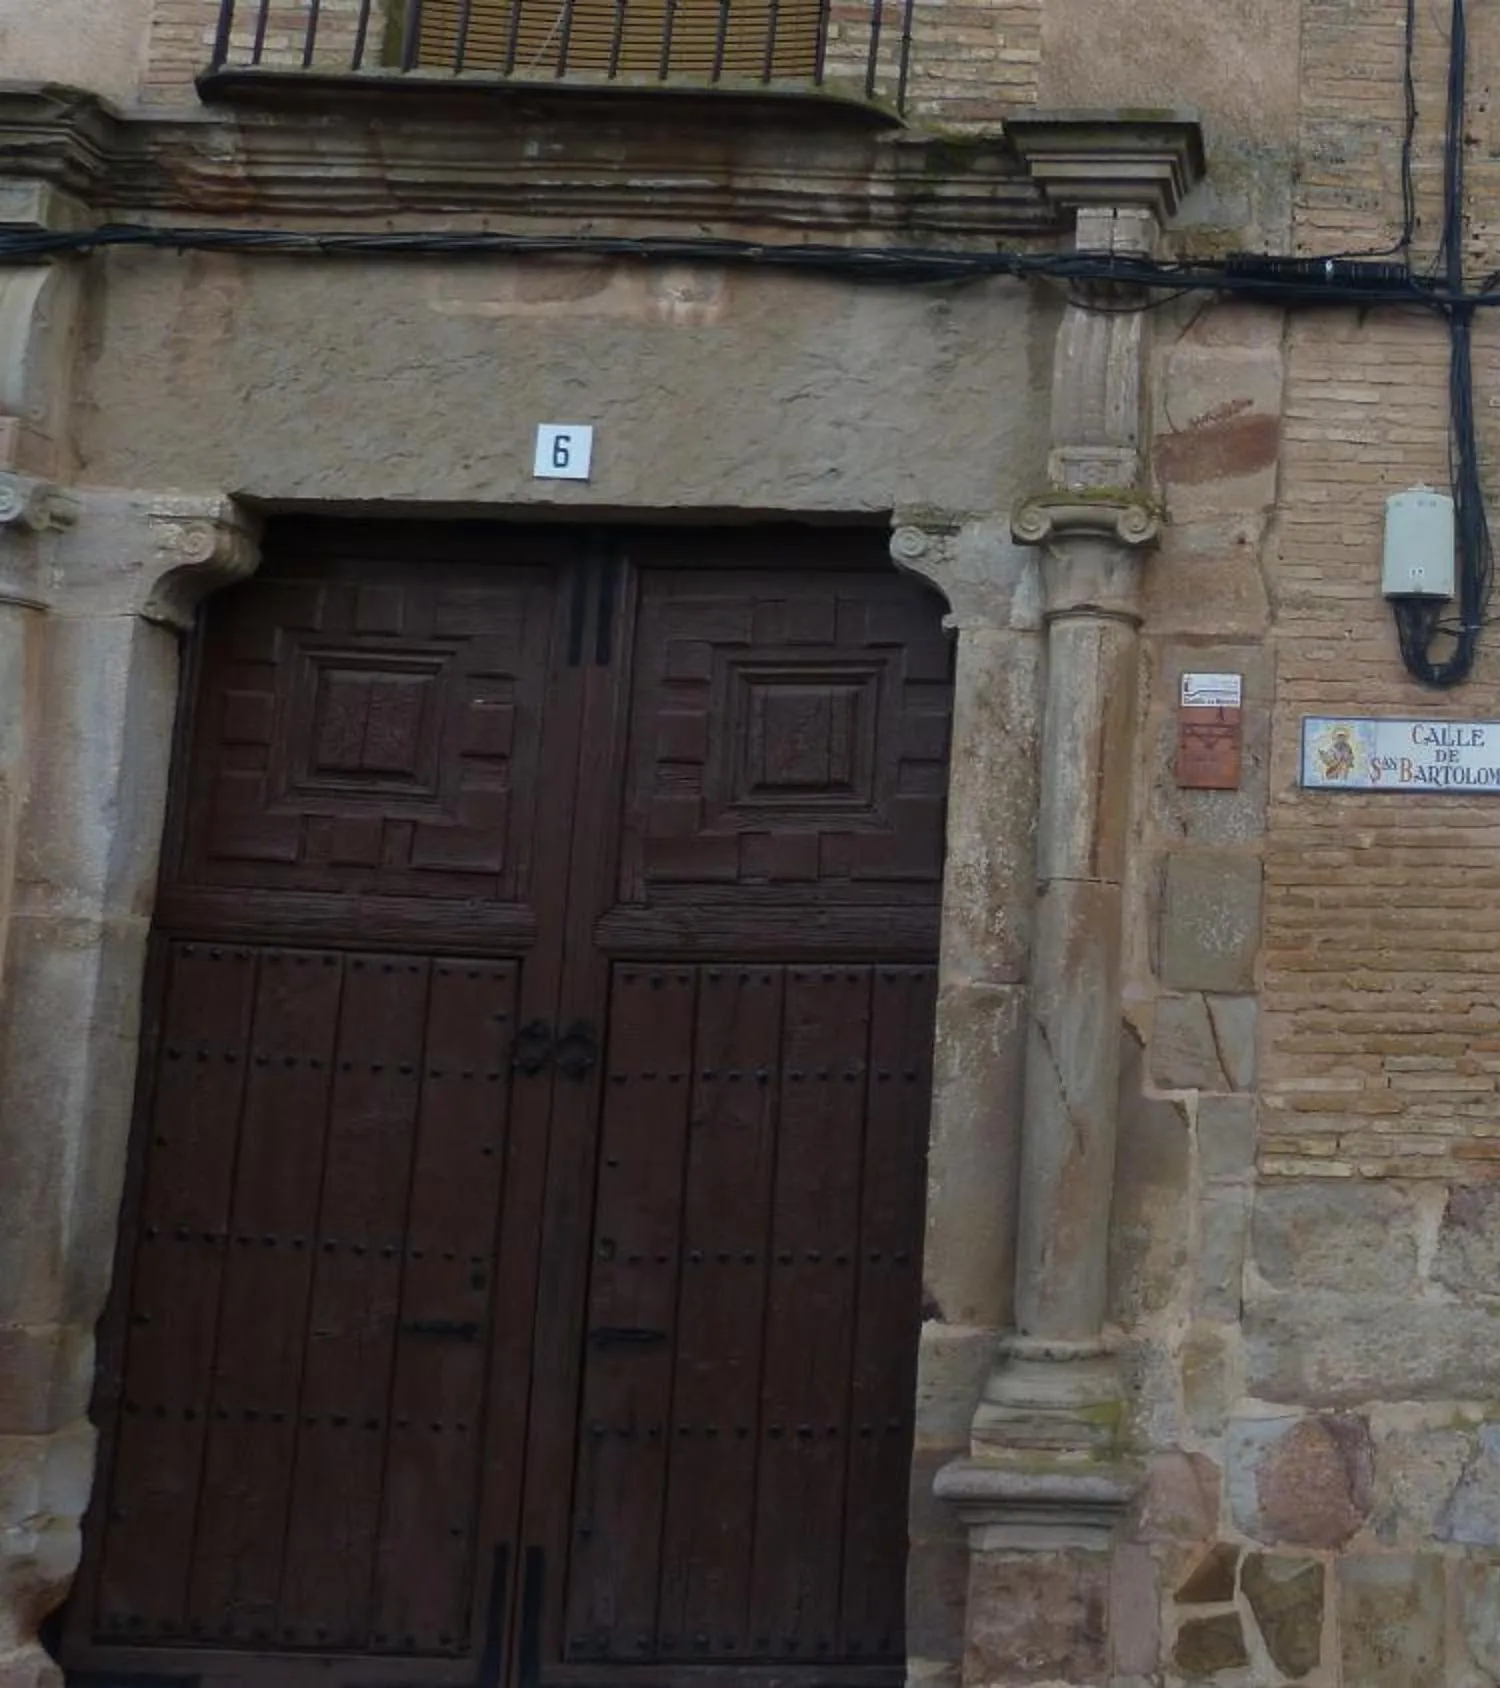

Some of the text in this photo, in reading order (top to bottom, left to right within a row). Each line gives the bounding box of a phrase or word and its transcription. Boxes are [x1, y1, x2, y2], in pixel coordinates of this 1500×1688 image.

[553, 435, 570, 468] 6
[1411, 723, 1485, 747] CALLE
[1434, 749, 1460, 763] DE
